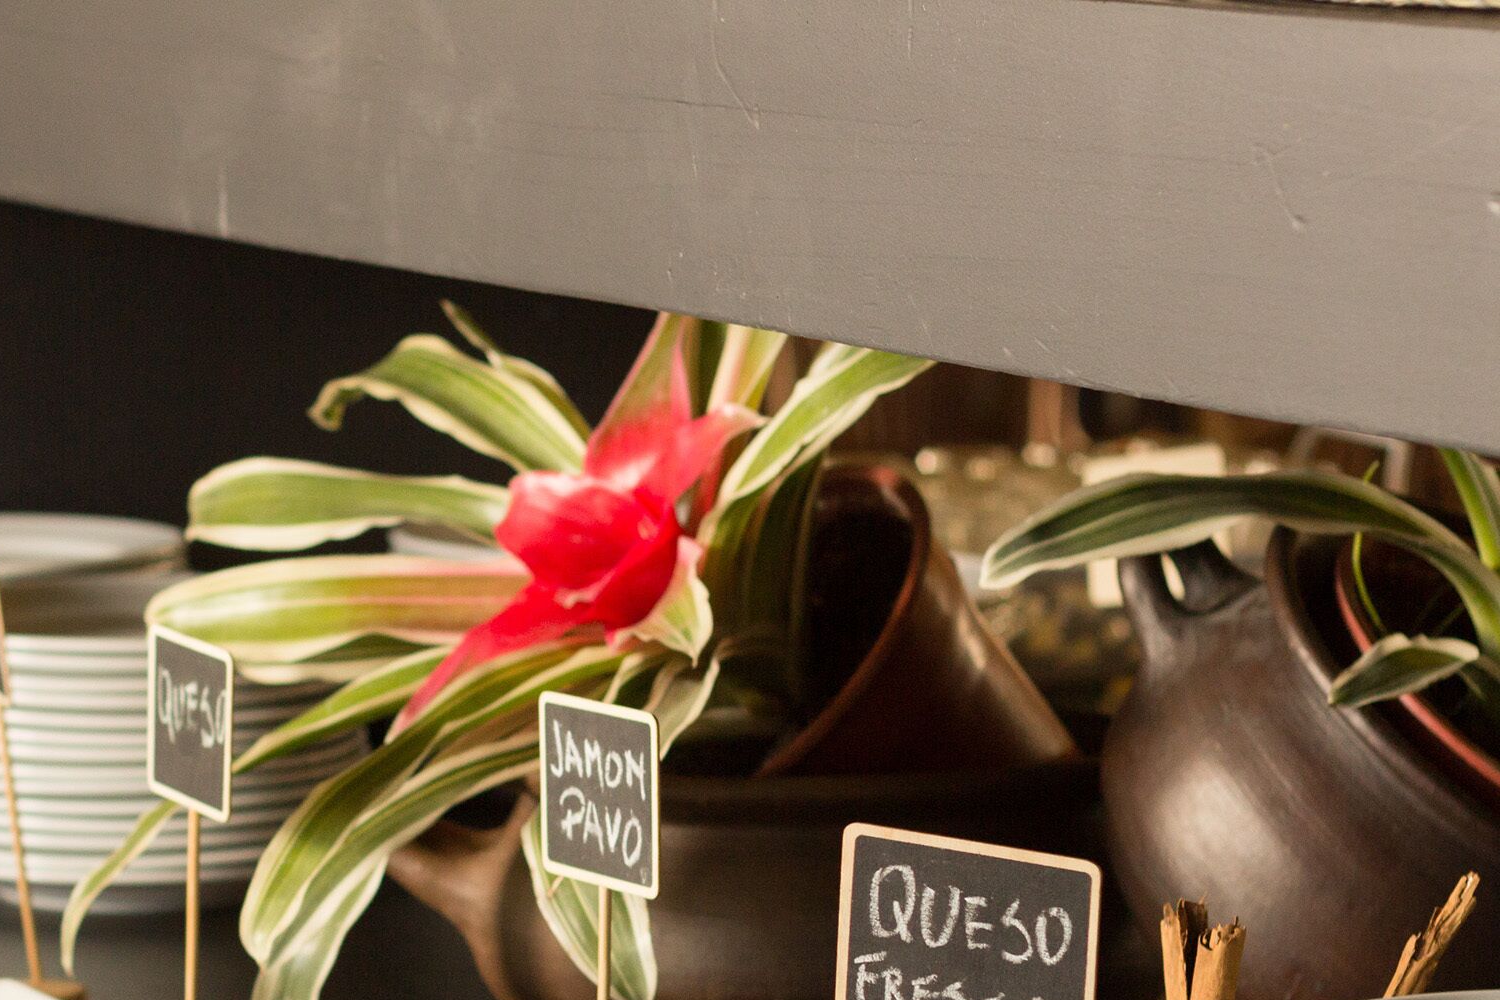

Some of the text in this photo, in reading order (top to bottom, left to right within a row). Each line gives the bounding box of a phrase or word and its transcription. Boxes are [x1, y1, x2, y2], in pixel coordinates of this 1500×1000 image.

[550, 718, 646, 801] JAMON
[559, 786, 643, 868] PAVO
[869, 864, 1073, 966] QUESO
